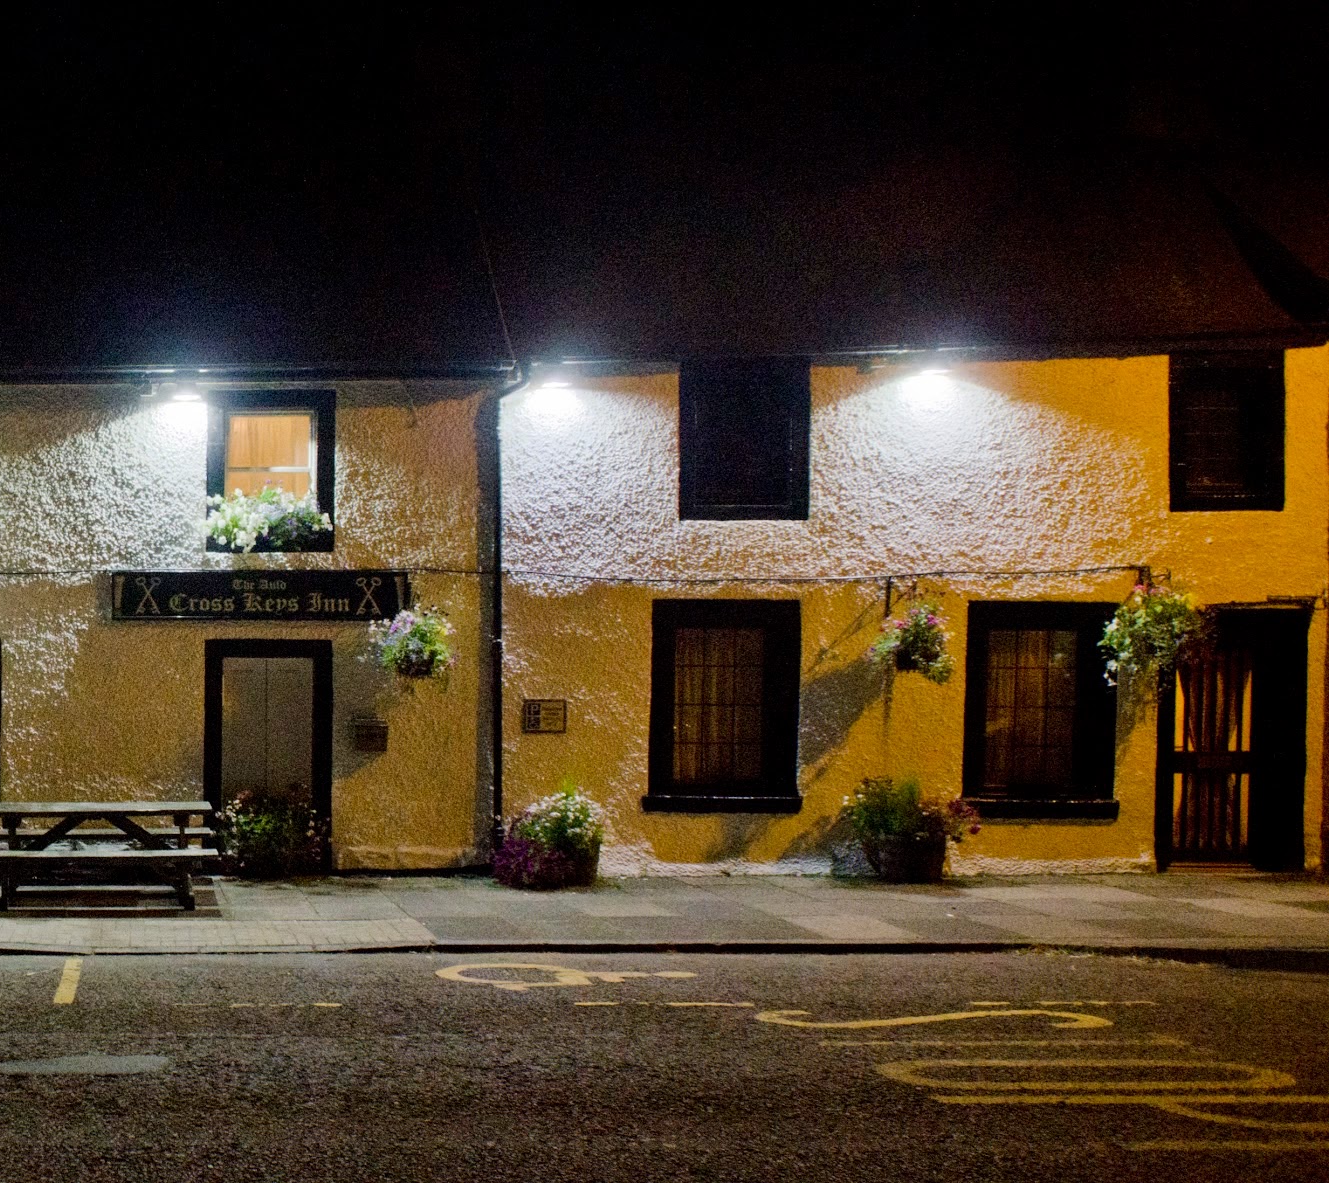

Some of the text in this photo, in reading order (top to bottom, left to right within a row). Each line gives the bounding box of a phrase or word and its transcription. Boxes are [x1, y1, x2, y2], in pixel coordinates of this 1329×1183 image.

[231, 578, 288, 590] The Auld
[168, 592, 351, 615] Cross Keys Inn
